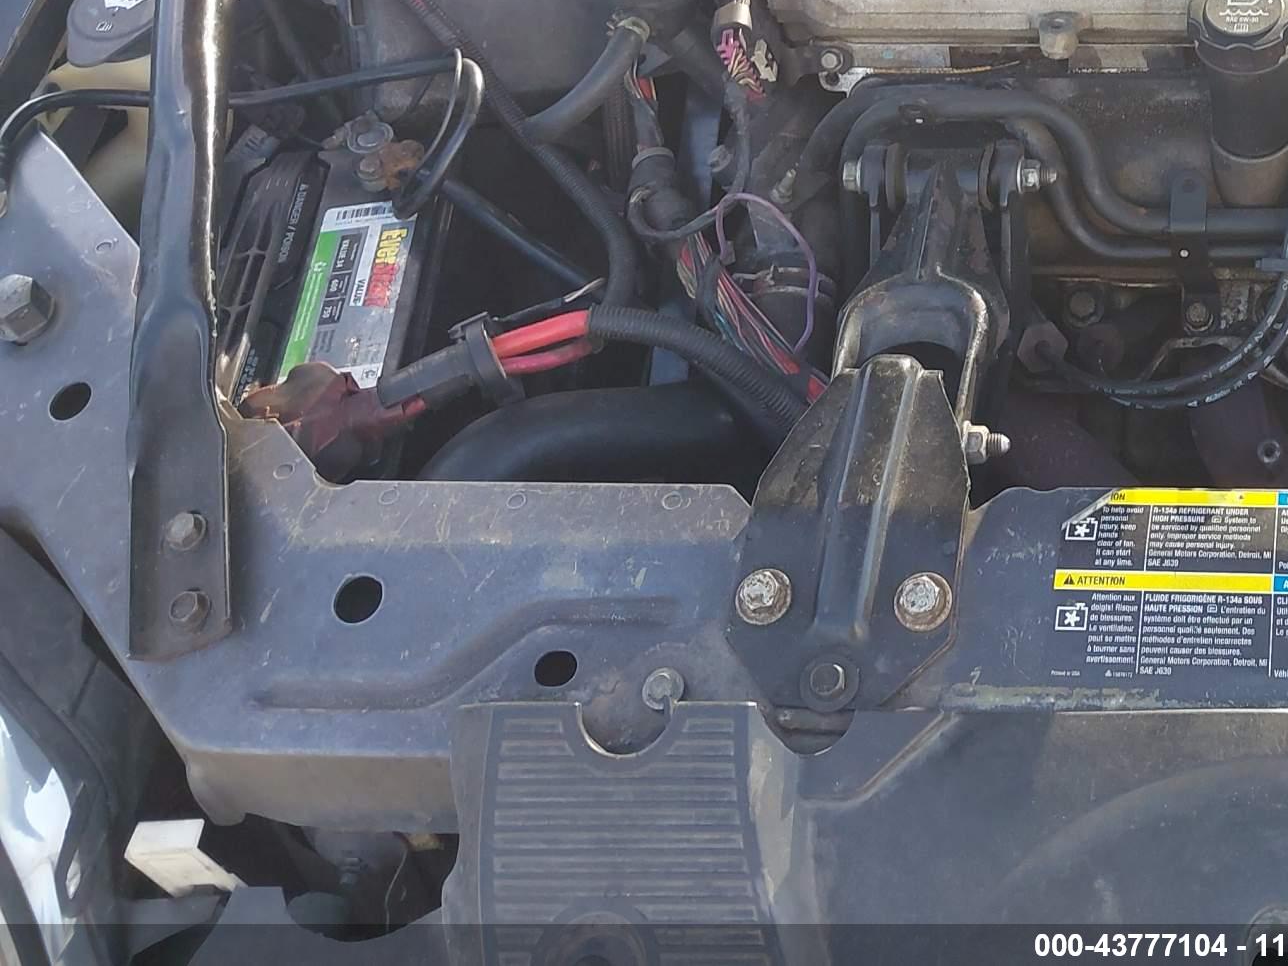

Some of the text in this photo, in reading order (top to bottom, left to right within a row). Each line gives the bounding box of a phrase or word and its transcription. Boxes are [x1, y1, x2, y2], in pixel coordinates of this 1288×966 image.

[1200, 525, 1227, 533] qualified
[1185, 542, 1214, 550] personal
[1149, 549, 1173, 557] General
[1198, 551, 1236, 559] Corporation,
[1103, 558, 1133, 567] any time.
[1077, 576, 1125, 585] ATTENTION
[1218, 596, 1242, 604] R-134a
[1244, 596, 1263, 604] SOUS
[1115, 604, 1138, 612] Risque
[1168, 605, 1203, 613] PRESSION
[1221, 606, 1255, 614] L'entretien
[1100, 614, 1133, 622] blessures.
[1144, 615, 1171, 624] système
[1188, 615, 1200, 623] être
[1142, 626, 1176, 634] personnel
[1242, 627, 1255, 635] Des
[1088, 635, 1103, 643] peut
[1177, 636, 1212, 644] d'entretien
[1214, 637, 1251, 645] incorrectes
[1140, 656, 1166, 664] General
[1167, 657, 1190, 665] Motors
[1192, 658, 1231, 667] Corporation,
[1140, 666, 1153, 674] SAE
